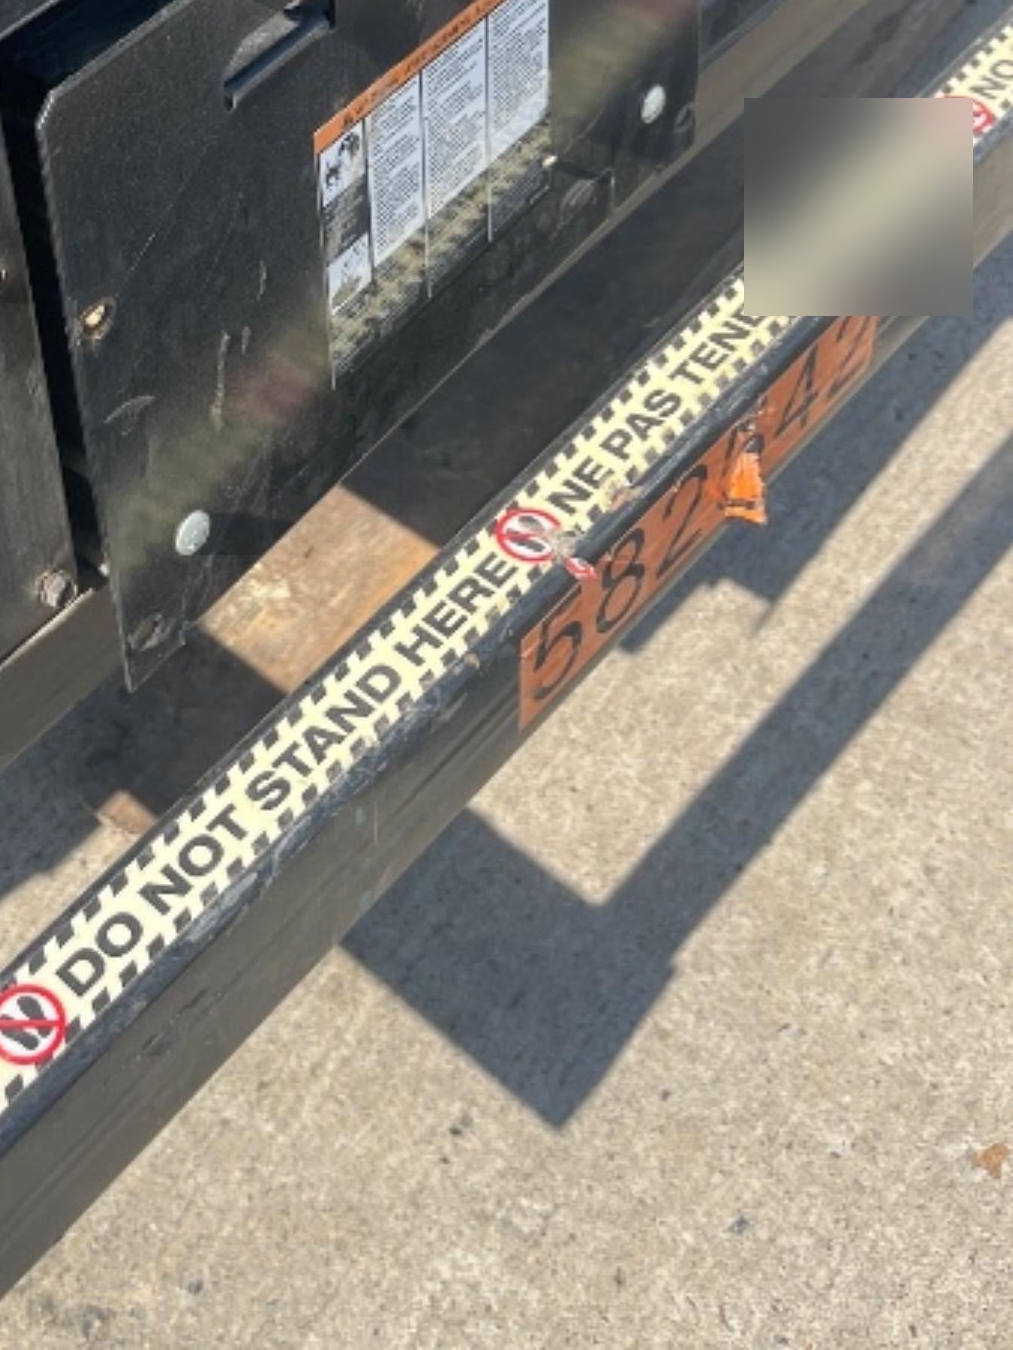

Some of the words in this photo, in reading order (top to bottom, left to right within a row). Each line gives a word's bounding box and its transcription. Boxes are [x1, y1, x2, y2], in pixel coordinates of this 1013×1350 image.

[545, 460, 615, 516] NE
[600, 389, 683, 463] PAS
[668, 302, 768, 385] TEN
[54, 911, 144, 1001] DO
[137, 810, 255, 917] NOT
[244, 663, 407, 813] STAND
[395, 555, 518, 669] HERE
